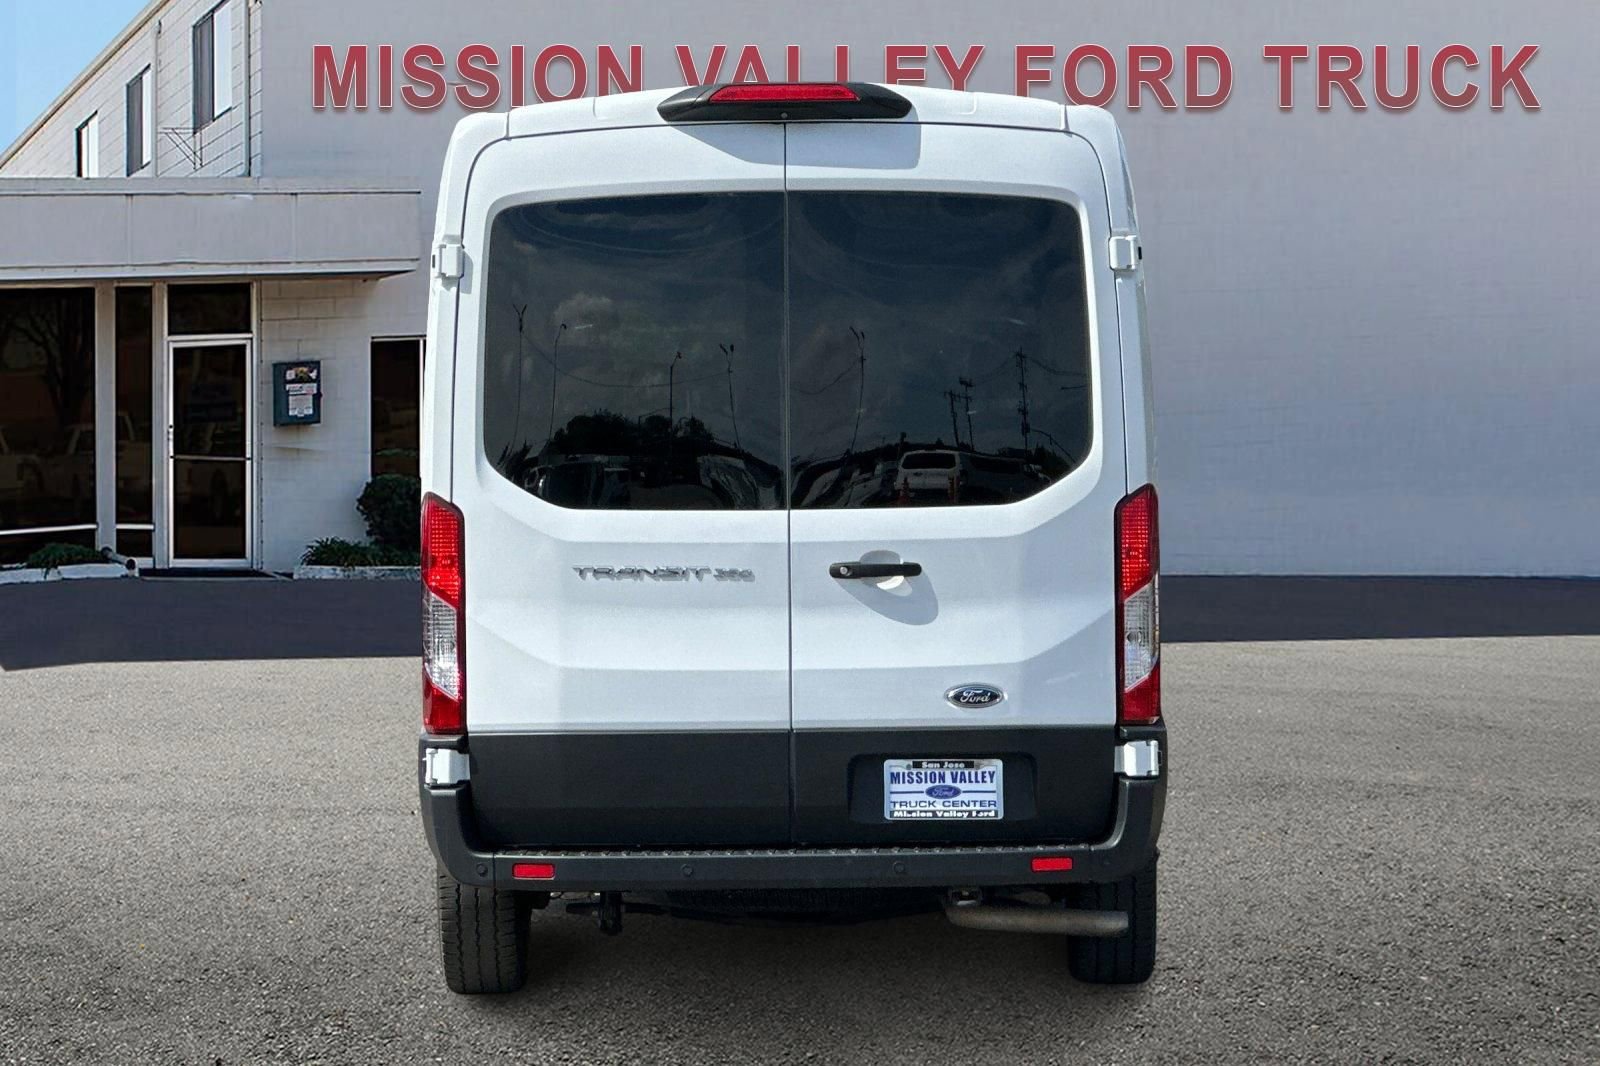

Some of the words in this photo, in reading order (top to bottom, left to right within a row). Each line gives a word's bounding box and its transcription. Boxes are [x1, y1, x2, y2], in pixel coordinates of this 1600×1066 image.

[312, 43, 643, 109] MISSION
[1015, 43, 1233, 108] FORD
[1263, 44, 1541, 108] TRUCK
[572, 566, 712, 581] TRANSIT
[960, 689, 991, 703] Ford
[921, 761, 940, 769] San
[943, 761, 965, 769] Jose
[890, 771, 946, 784] MISSION
[950, 770, 996, 784] VALLEY
[931, 787, 955, 797] Ford
[890, 800, 937, 809] TRUCK
[942, 799, 997, 808] CENTER
[936, 810, 969, 819] Valley
